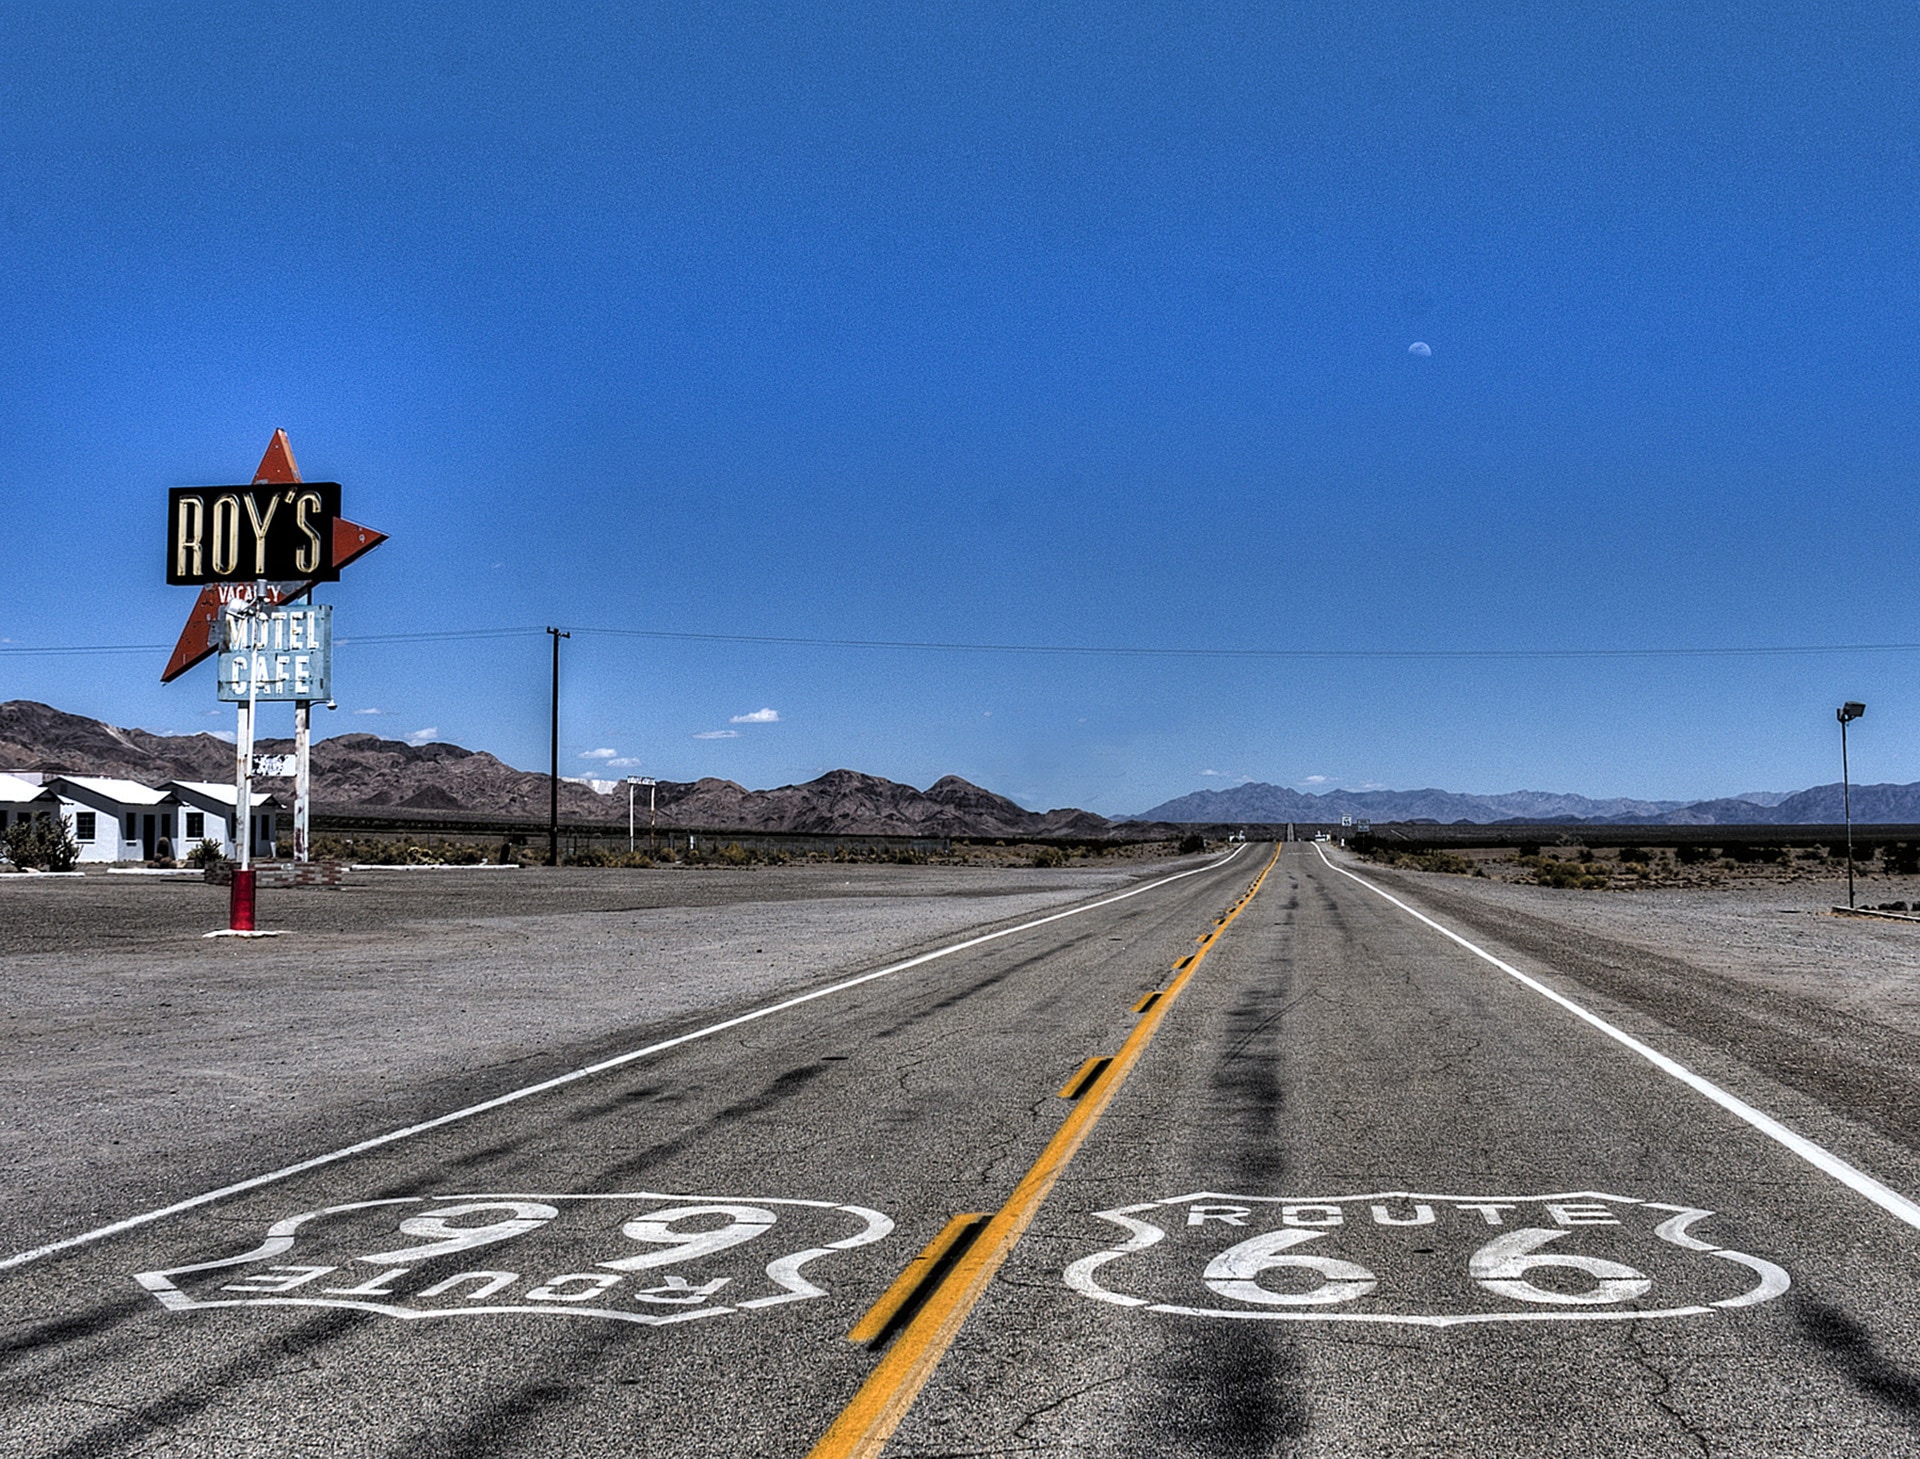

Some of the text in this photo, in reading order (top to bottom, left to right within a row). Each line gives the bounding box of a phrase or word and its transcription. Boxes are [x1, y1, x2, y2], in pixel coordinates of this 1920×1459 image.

[176, 488, 322, 576] ROY'S
[226, 611, 319, 650] MOTEL
[231, 656, 310, 694] CAFE
[1187, 1204, 1621, 1226] ROUTE
[222, 1265, 733, 1304] ROUTE
[1203, 1228, 1653, 1305] 66
